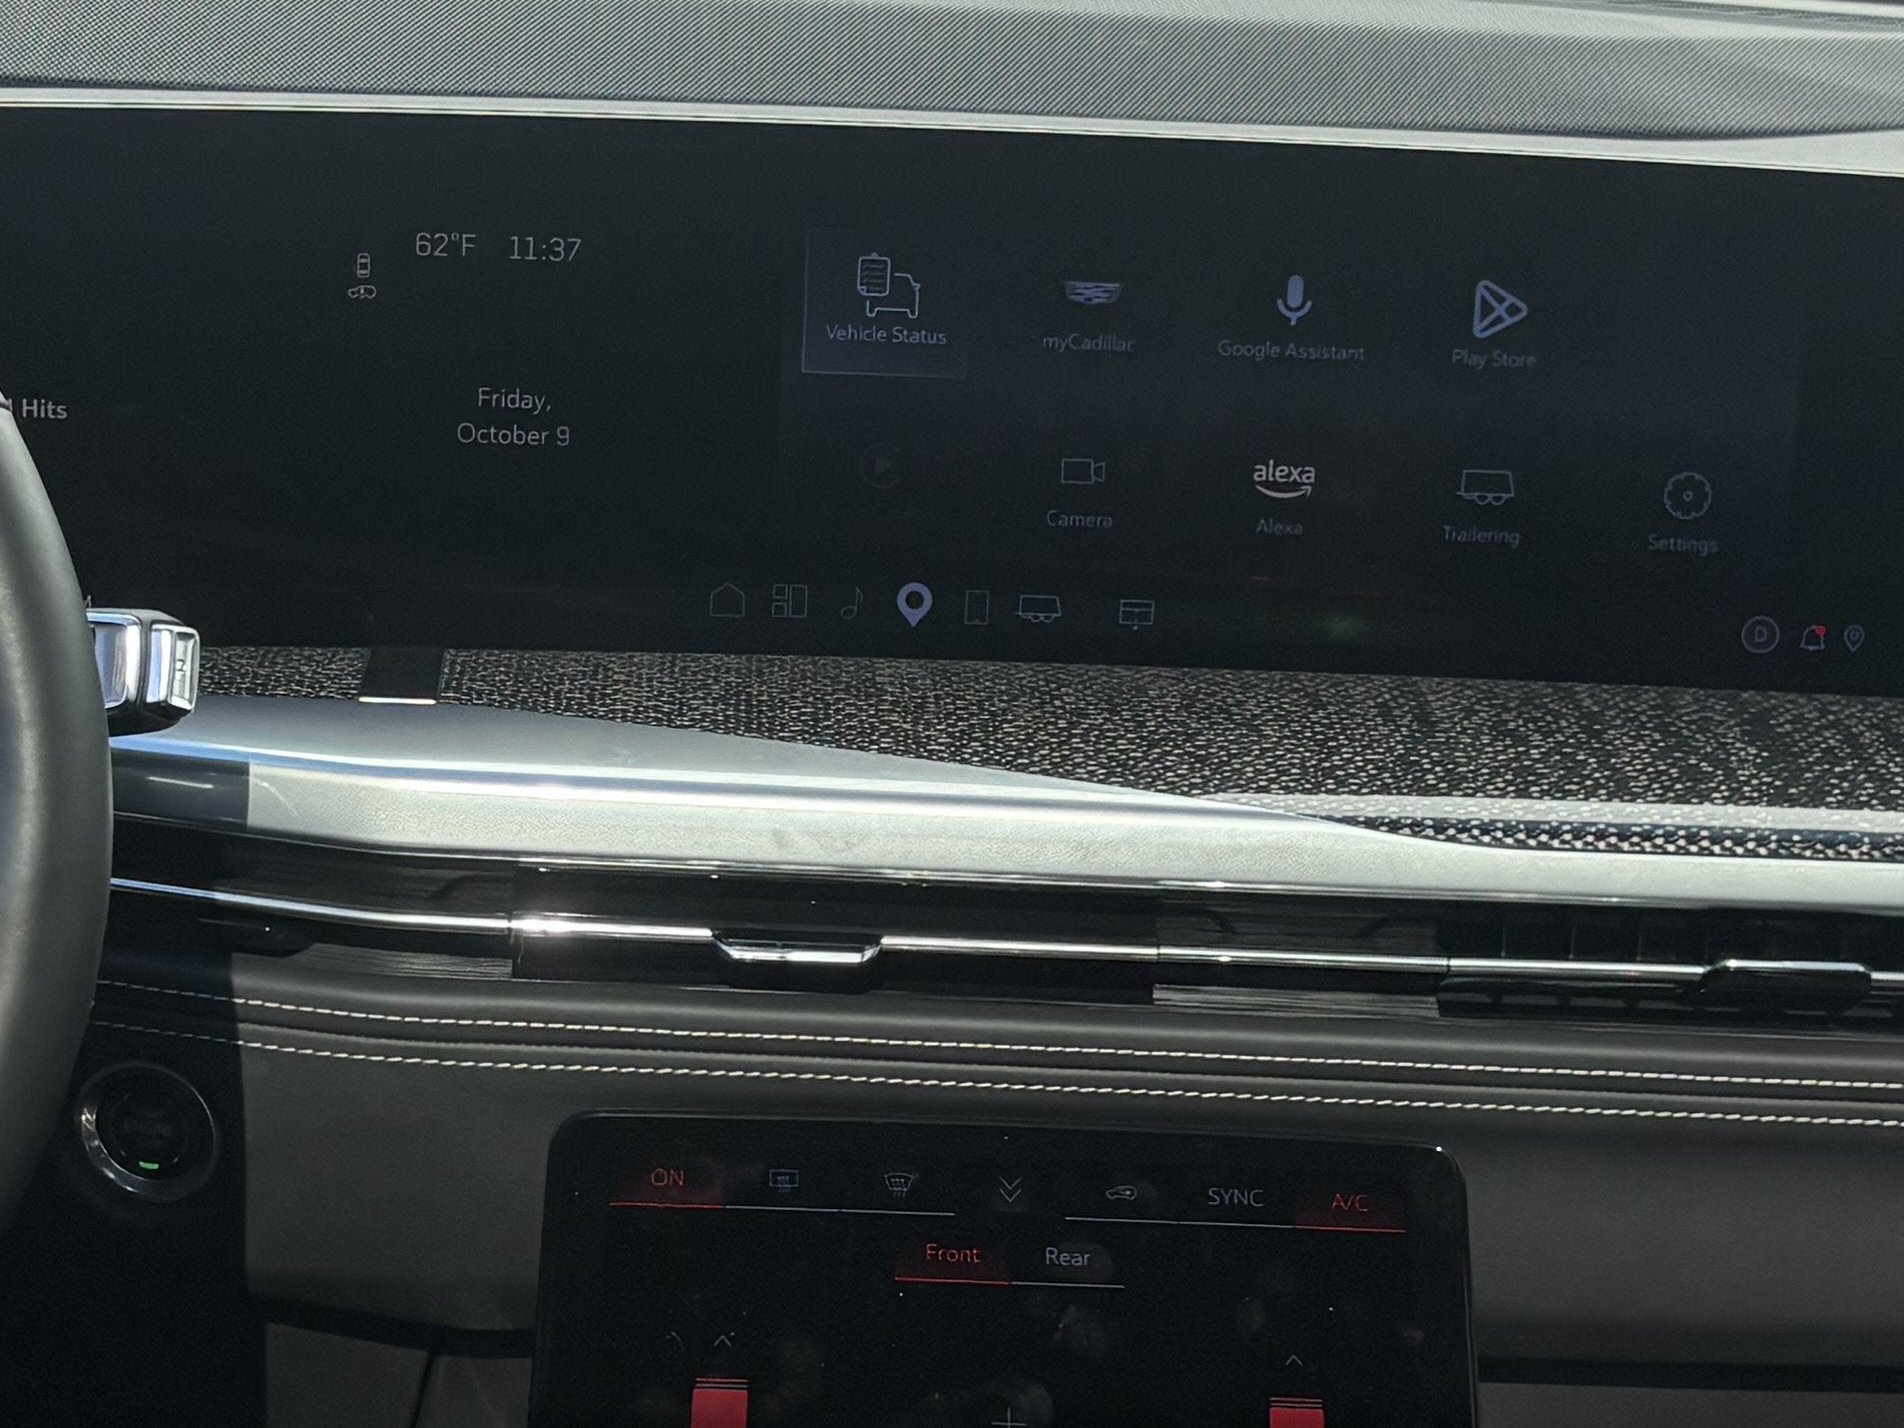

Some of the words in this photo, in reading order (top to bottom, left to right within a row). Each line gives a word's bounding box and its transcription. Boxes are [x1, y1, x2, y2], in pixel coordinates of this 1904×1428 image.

[415, 231, 478, 259] 62°F
[508, 235, 583, 263] 11:37
[825, 323, 898, 343] Vehicle
[901, 325, 948, 346] Status
[1041, 332, 1138, 355] myCadillac
[1217, 339, 1281, 361] Google
[1284, 341, 1367, 362] Assistant
[1451, 347, 1489, 371] Play
[1492, 349, 1538, 369] Store
[22, 397, 69, 420] Hits
[478, 386, 552, 416] Friday,
[457, 422, 551, 446] October
[556, 424, 571, 447] 9
[1253, 458, 1318, 484] alexa
[1045, 509, 1114, 529] Camera
[1254, 517, 1305, 537] Alexa
[1441, 524, 1521, 550] Trailering
[1646, 533, 1719, 558] Settings
[652, 1167, 687, 1188] ON
[1208, 1186, 1265, 1208] SYNC
[1331, 1190, 1370, 1214] A/C
[926, 1242, 983, 1266] Front
[1045, 1245, 1092, 1269] Rear
